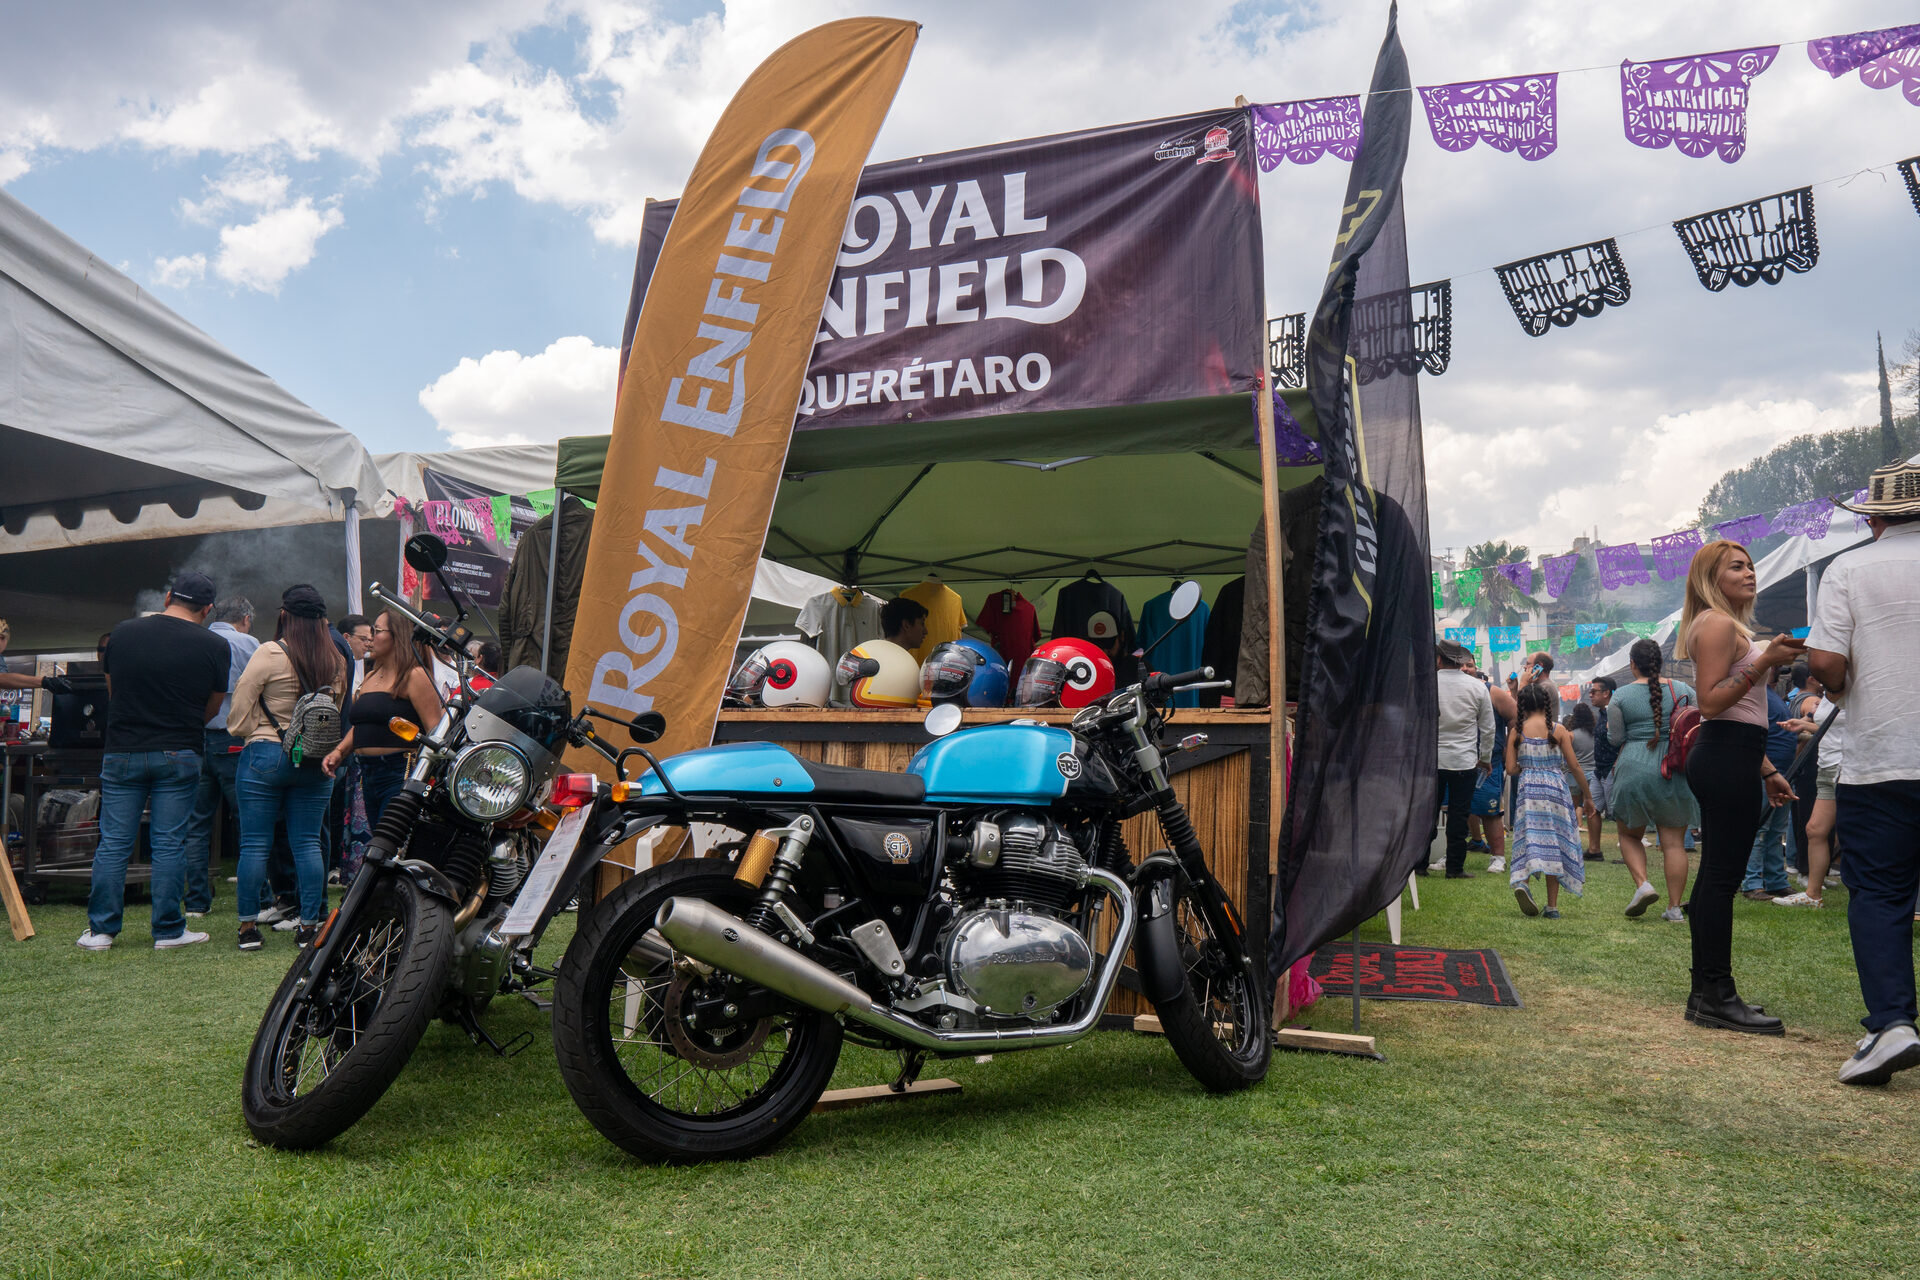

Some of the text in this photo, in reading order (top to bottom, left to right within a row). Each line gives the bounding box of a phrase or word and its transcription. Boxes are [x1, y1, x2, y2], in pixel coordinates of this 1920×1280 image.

[836, 171, 1047, 268] OYAL
[815, 247, 1087, 344] NFIELD
[587, 128, 816, 716] ROYAL ENFIELD
